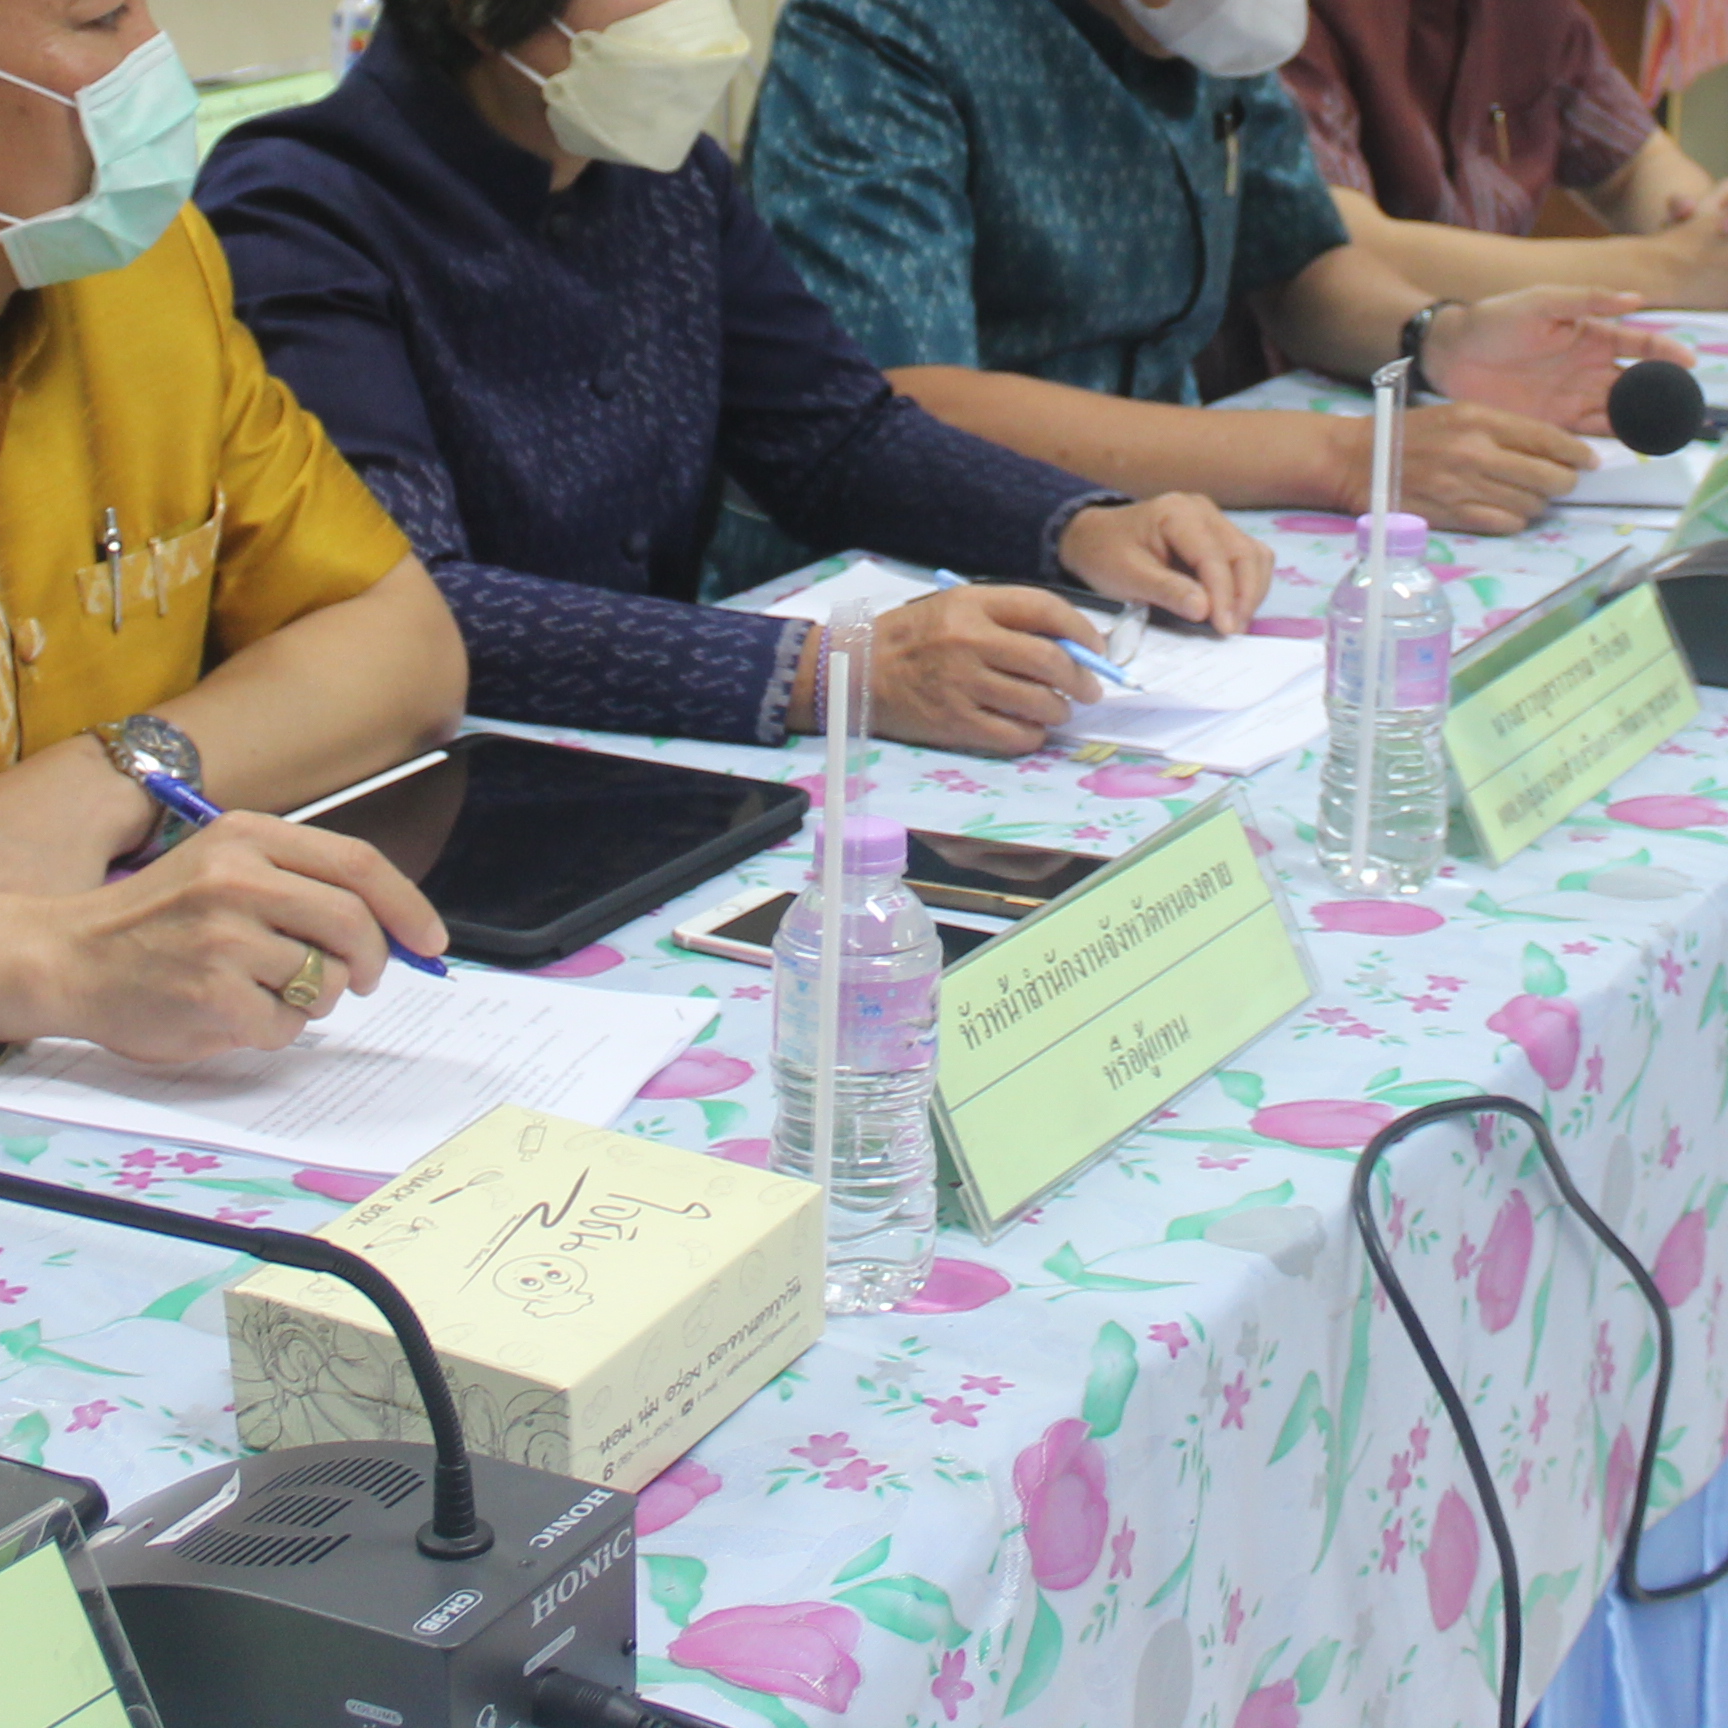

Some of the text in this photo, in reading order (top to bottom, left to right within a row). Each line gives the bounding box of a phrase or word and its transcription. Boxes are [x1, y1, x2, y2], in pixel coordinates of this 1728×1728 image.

[958, 860, 1235, 1051] หัวหน้าสำนักงานจังหวัดหนองคาย
[1102, 1014, 1192, 1091] หรือผู้แทน
[665, 1362, 702, 1402] อร่อย
